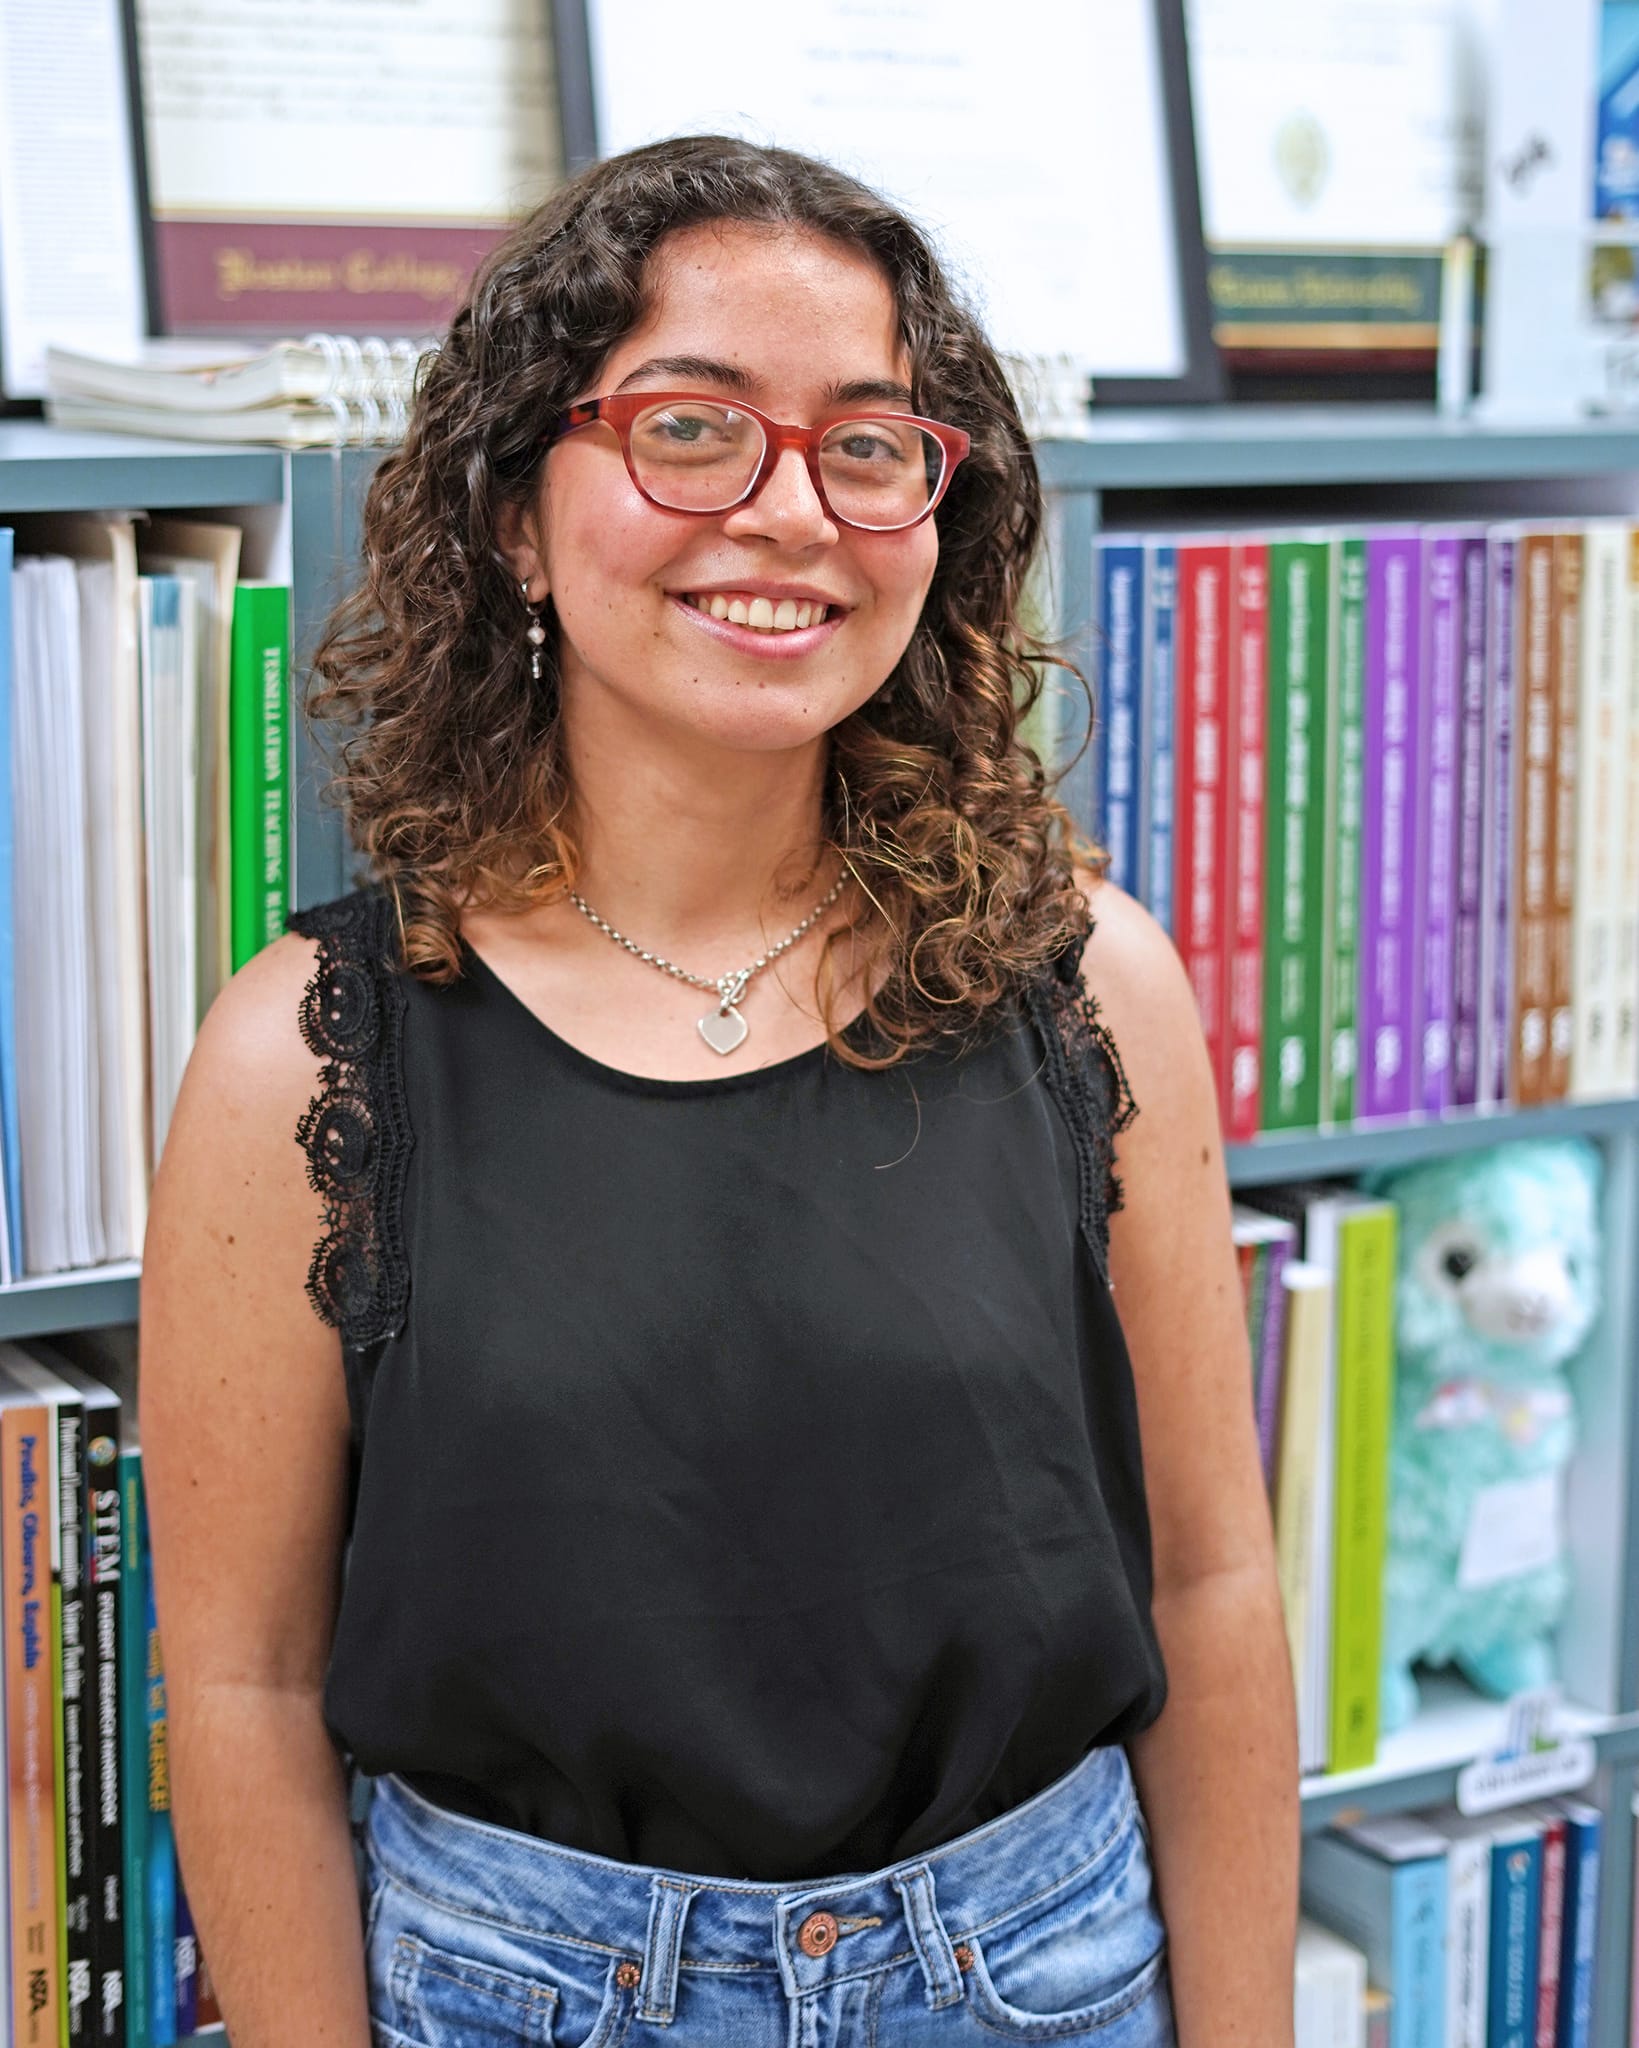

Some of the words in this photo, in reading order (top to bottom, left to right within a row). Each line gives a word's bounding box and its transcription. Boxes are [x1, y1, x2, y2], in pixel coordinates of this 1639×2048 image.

[263, 647, 283, 780] TESSELLATION
[264, 790, 283, 883] TEACHING
[95, 1489, 120, 1583] STEM
[98, 1592, 115, 1660] STUDENT
[99, 1662, 116, 1737] RESEARCH
[101, 1738, 117, 1826] HANDBOOK
